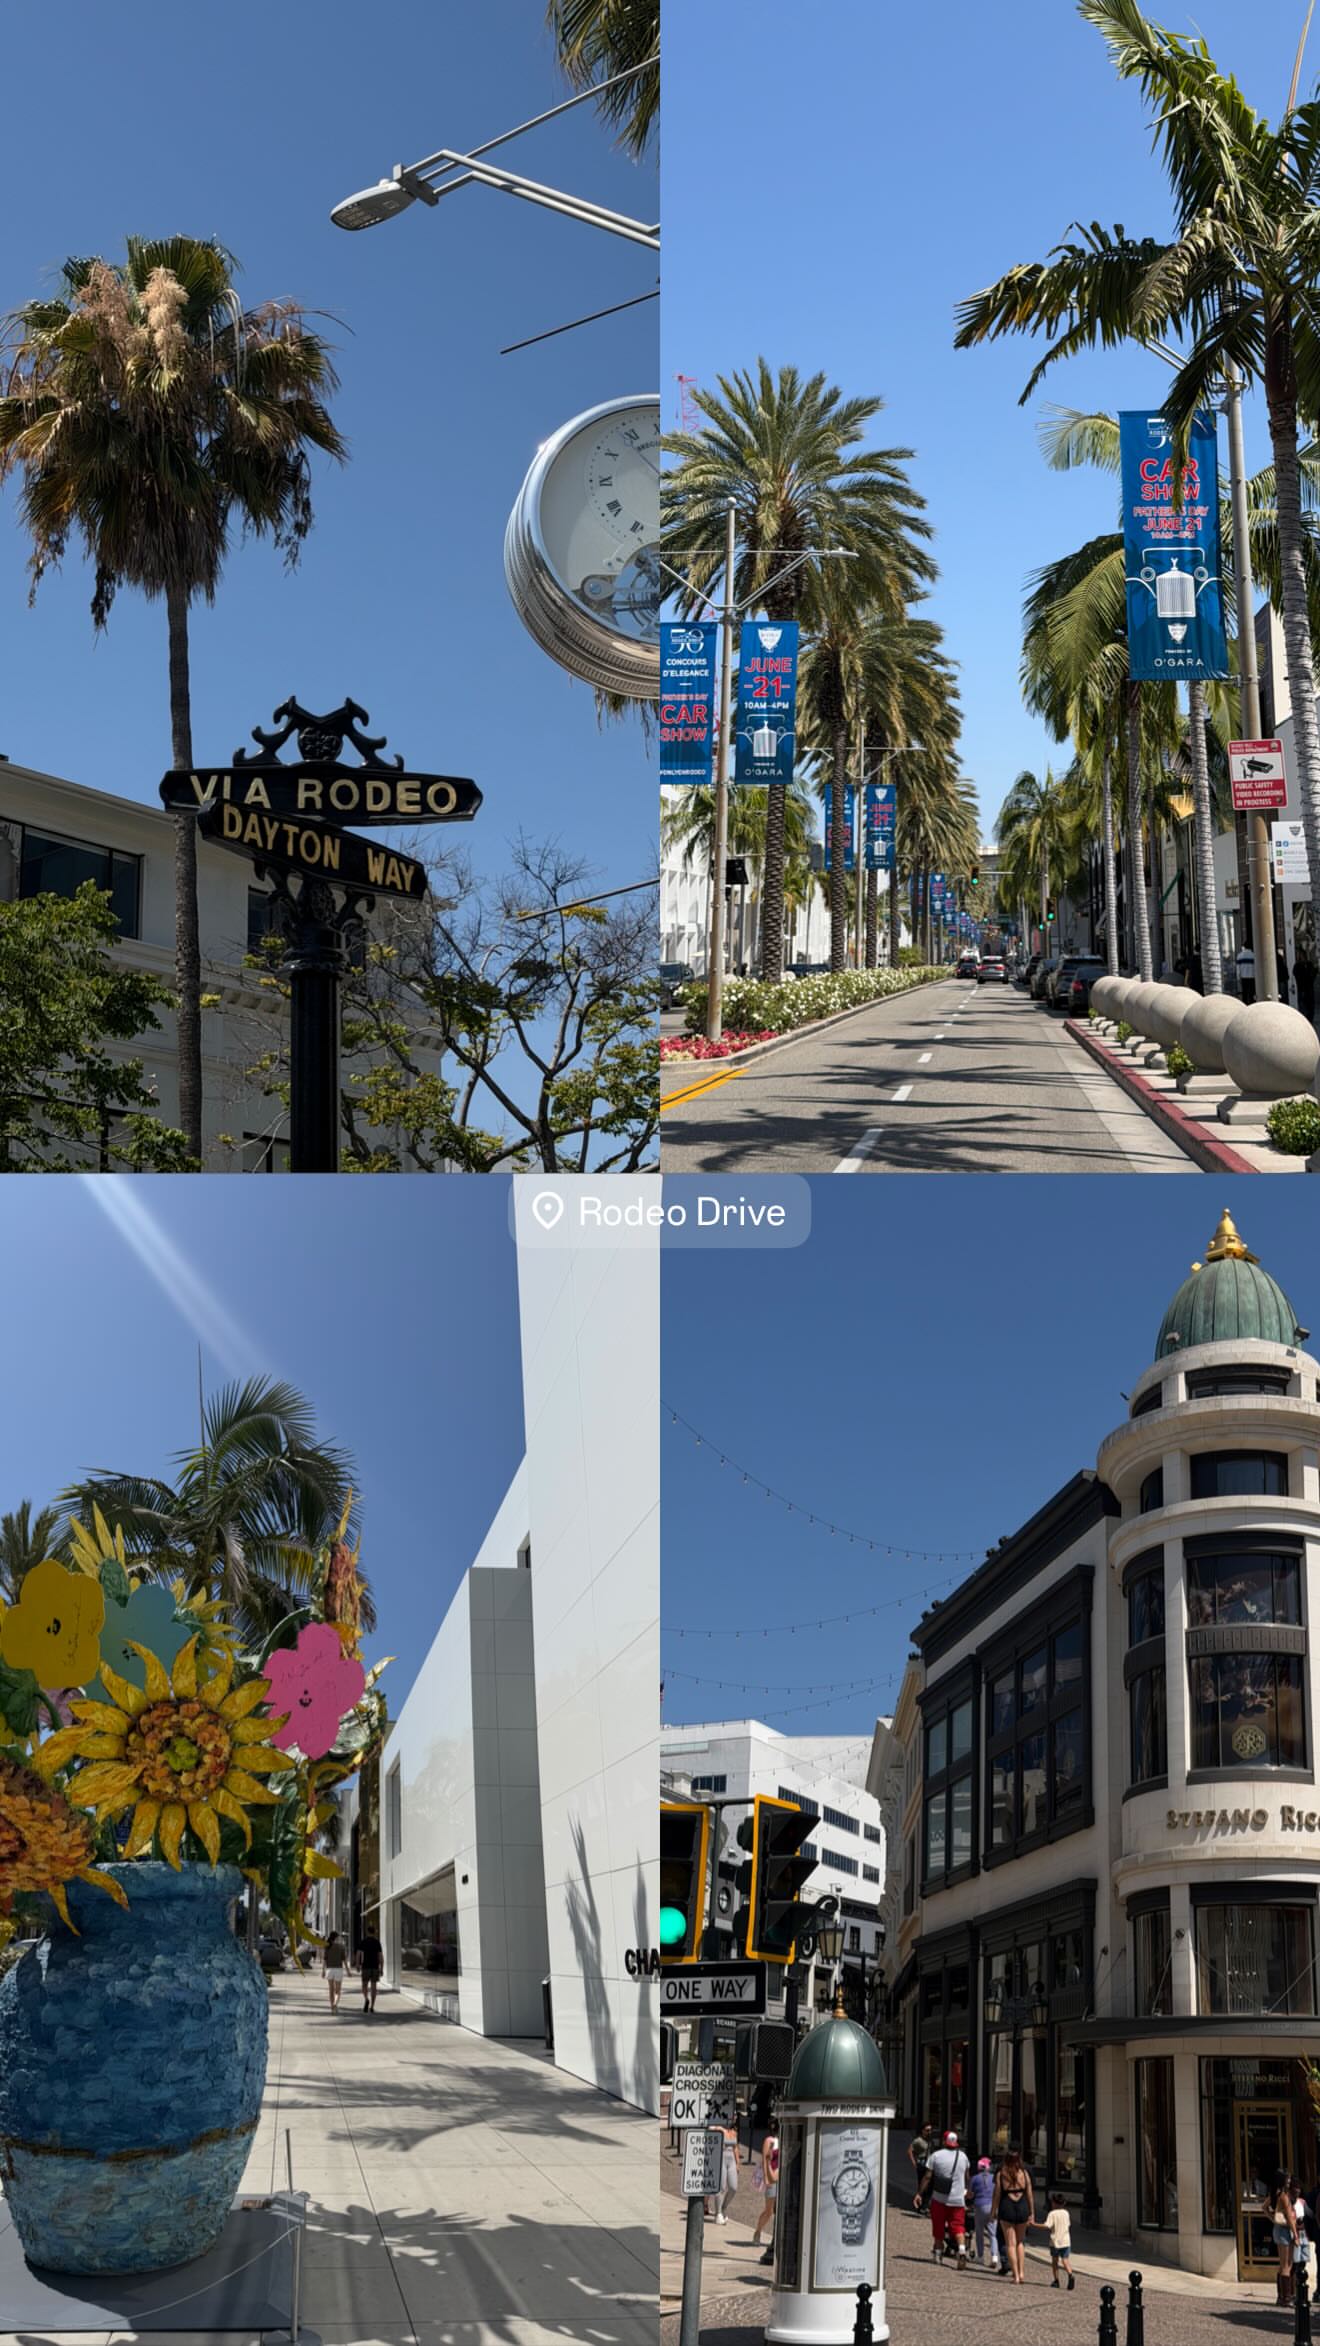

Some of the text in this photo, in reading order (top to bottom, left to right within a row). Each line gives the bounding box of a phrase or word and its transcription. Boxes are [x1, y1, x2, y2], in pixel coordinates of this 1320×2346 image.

[1143, 518, 1203, 531] JUNE 21
[666, 658, 708, 666] CONCOURS
[744, 657, 793, 673] JUNE
[1154, 658, 1205, 668] O'GARA
[662, 669, 710, 678] D'ELEGANCE
[661, 704, 708, 725] CAR
[660, 727, 708, 742] SHOW
[744, 768, 784, 777] O'GARA
[190, 775, 457, 814] VIA RODEO
[222, 803, 416, 893] DAYTON WAY
[1166, 1805, 1320, 1832] STEFANO RIC
[666, 1979, 748, 2000] ONE WAY
[677, 2064, 734, 2077] DIAGONAL
[675, 2079, 734, 2092] CROSSING
[674, 2099, 697, 2119] OK
[690, 2136, 719, 2145] CROSS
[692, 2147, 714, 2156] ONLY
[697, 2158, 709, 2167] ON
[691, 2169, 714, 2178] WALK
[686, 2181, 717, 2190] SIGNAL
